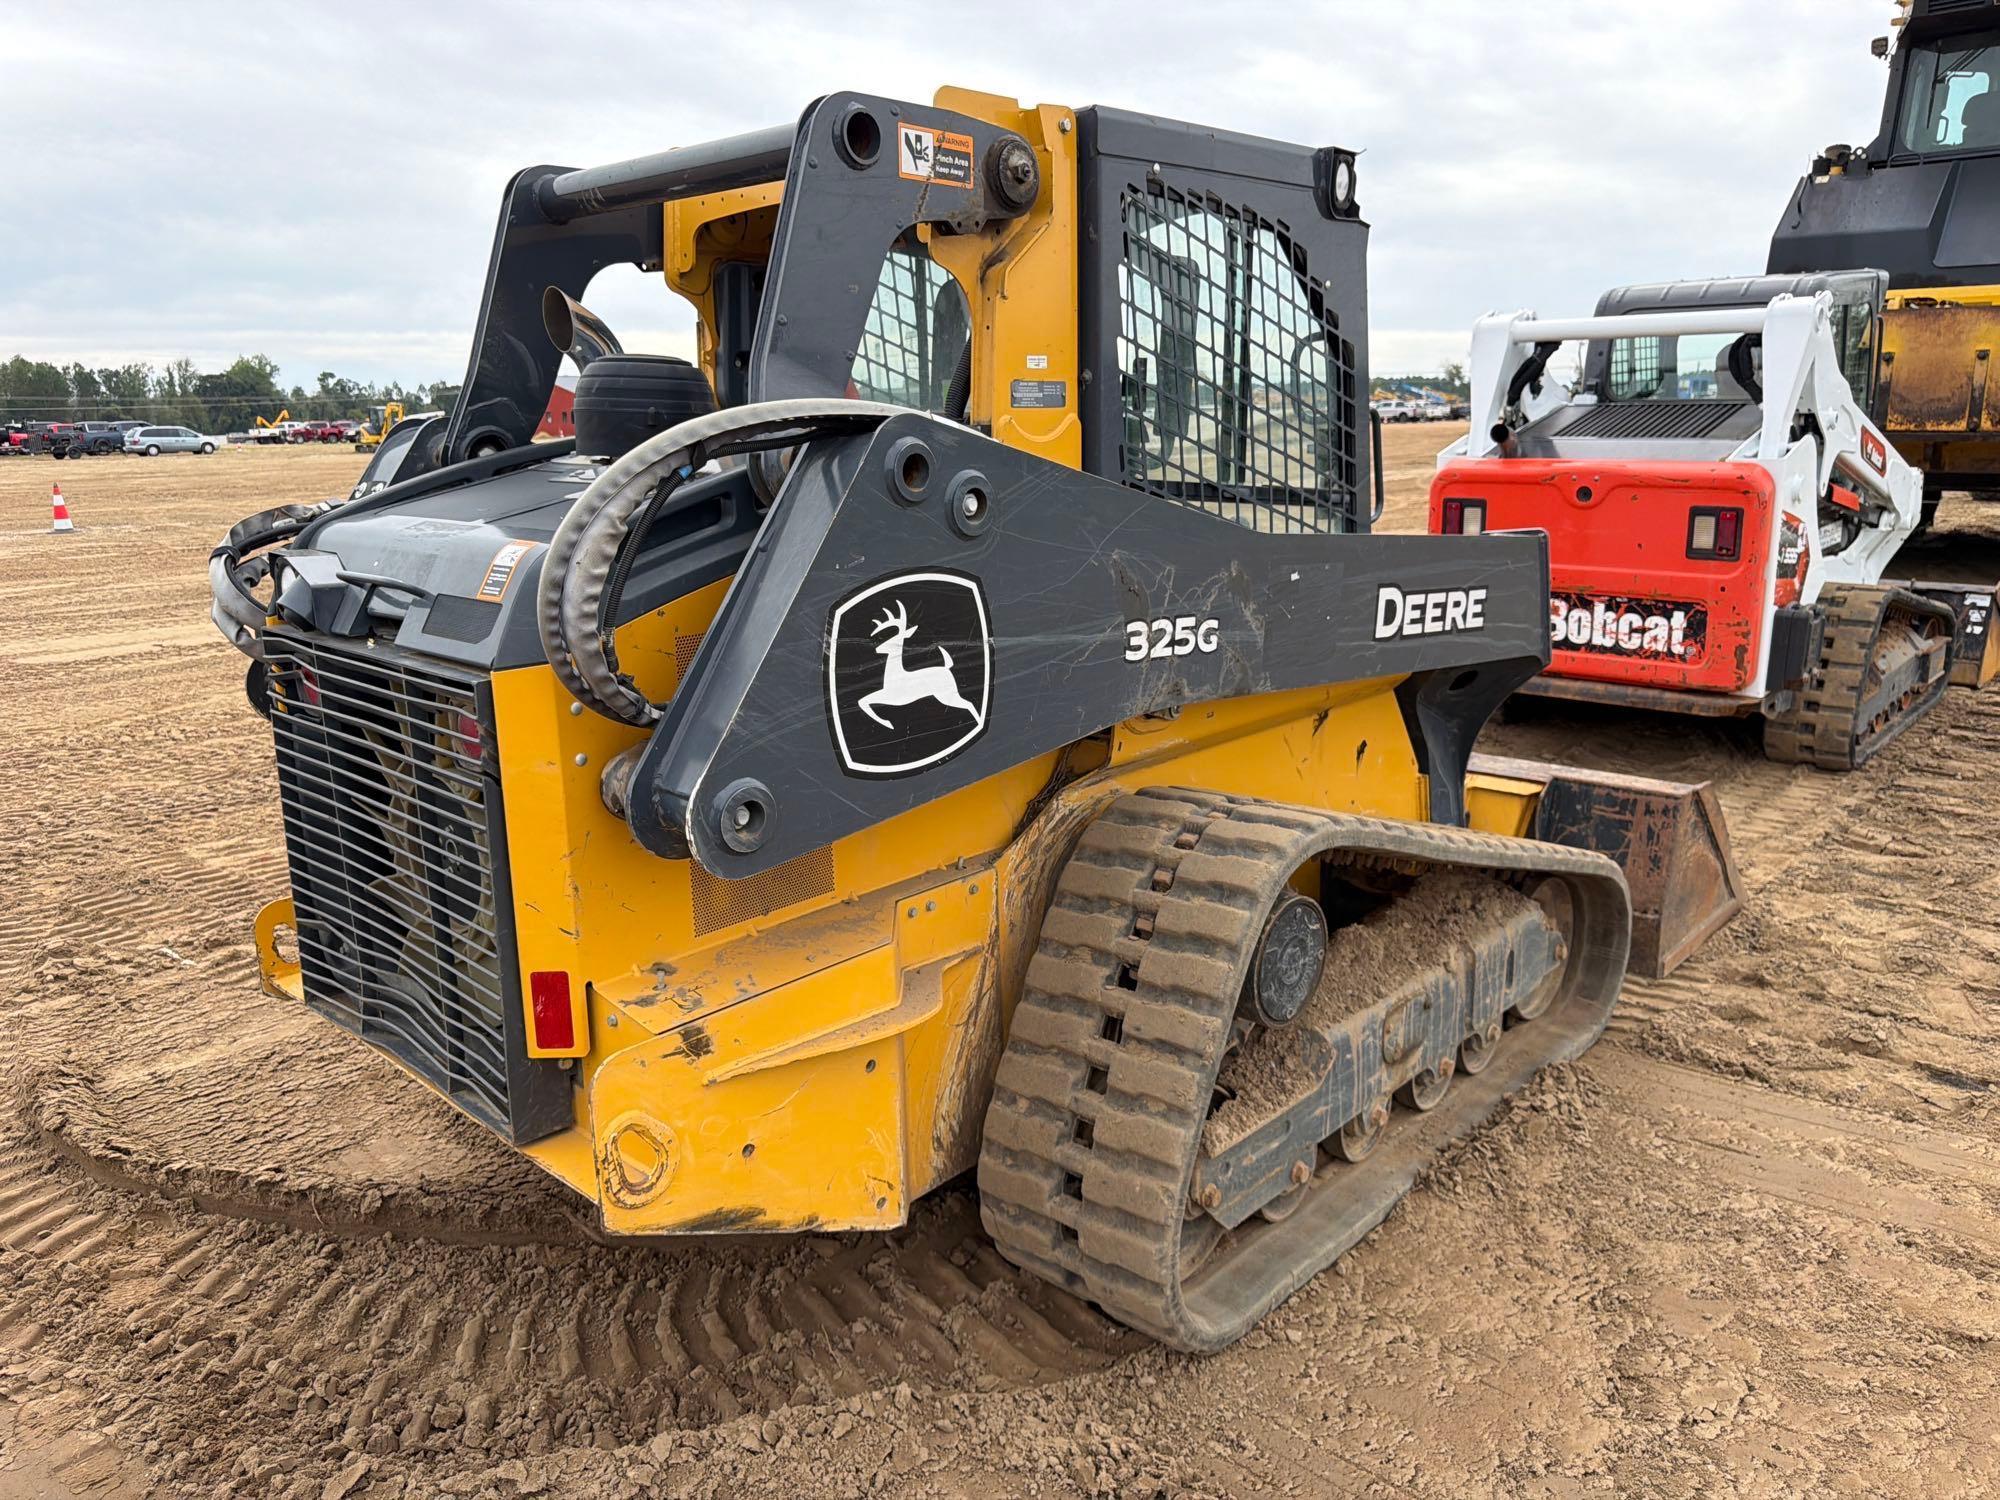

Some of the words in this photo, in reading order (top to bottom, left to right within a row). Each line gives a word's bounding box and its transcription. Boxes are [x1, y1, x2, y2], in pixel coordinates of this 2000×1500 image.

[936, 165, 949, 174] Keep
[950, 168, 964, 178] Away
[954, 156, 968, 166] Area
[1375, 587, 1487, 639] DEERE
[1550, 598, 1686, 655] Bobcat
[1125, 616, 1219, 661] 325G
